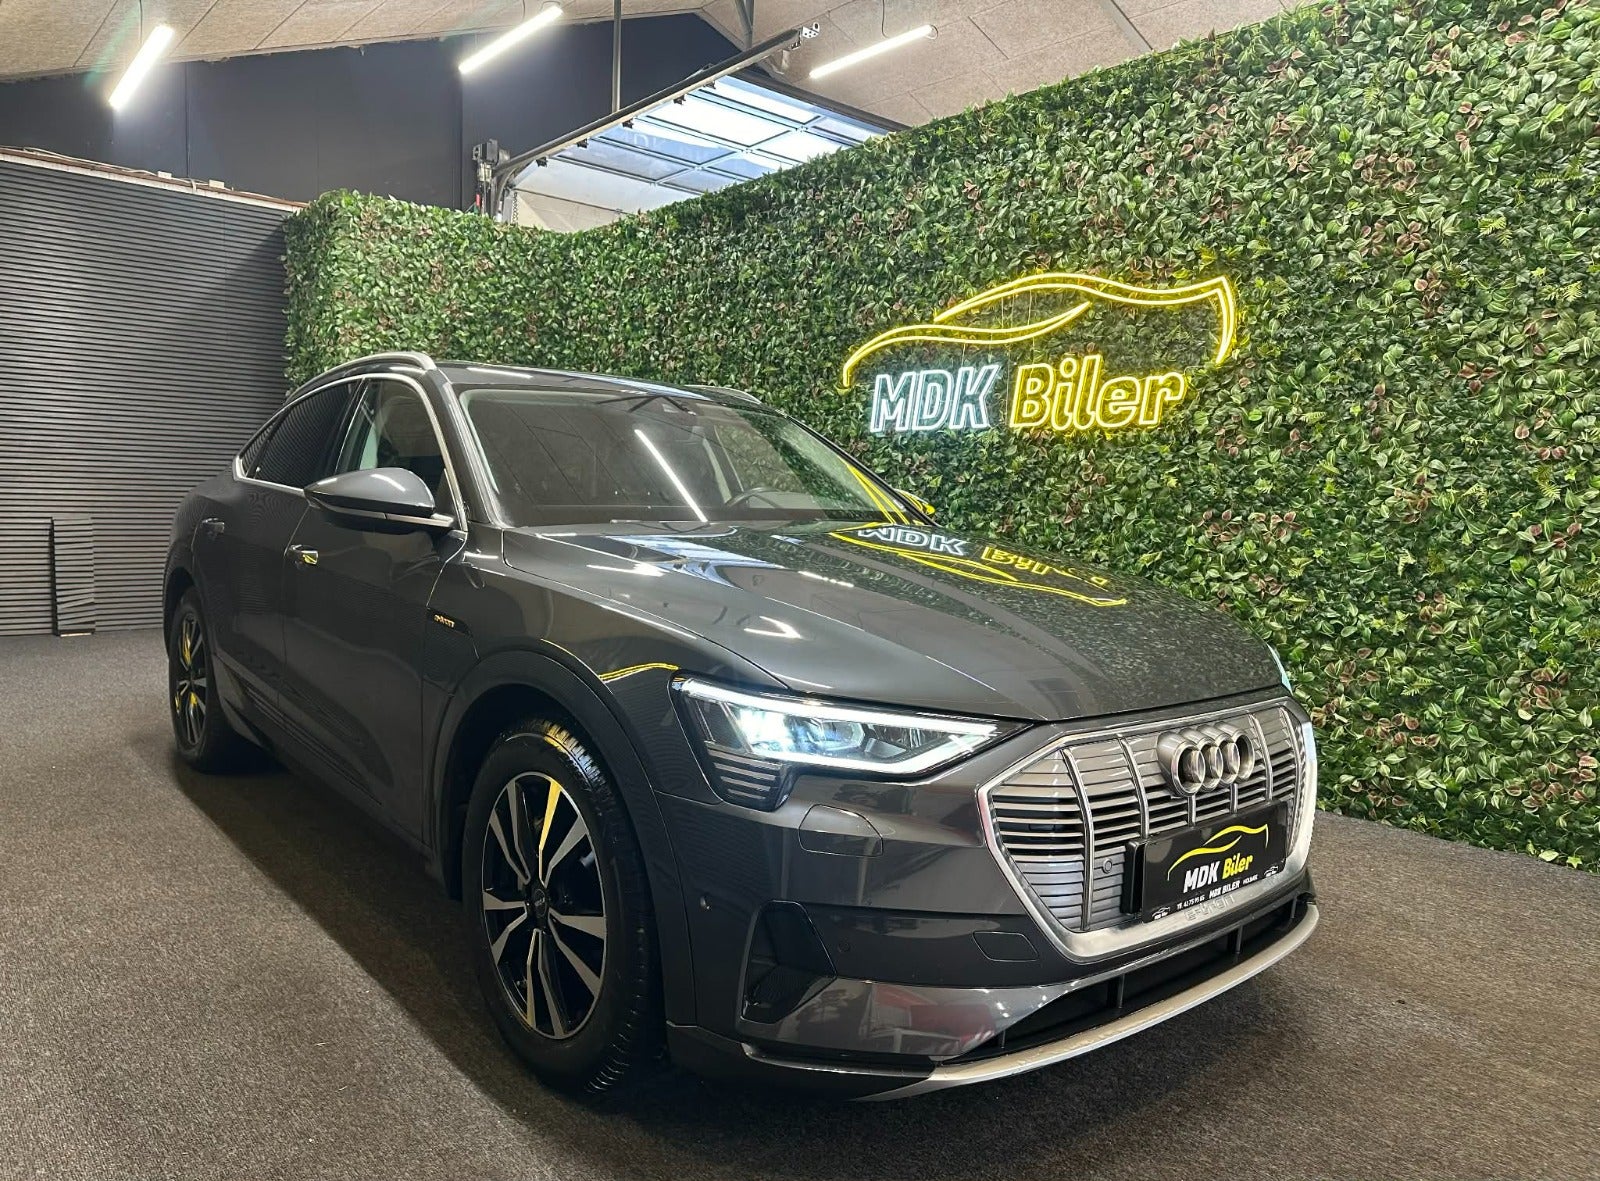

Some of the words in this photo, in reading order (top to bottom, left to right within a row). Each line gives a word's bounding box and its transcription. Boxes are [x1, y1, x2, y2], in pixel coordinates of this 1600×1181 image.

[870, 363, 1001, 433] MDK
[1009, 354, 1187, 431] Biler
[1183, 861, 1221, 893] MDK
[1222, 852, 1253, 880] Biler
[1222, 880, 1240, 894] BILER
